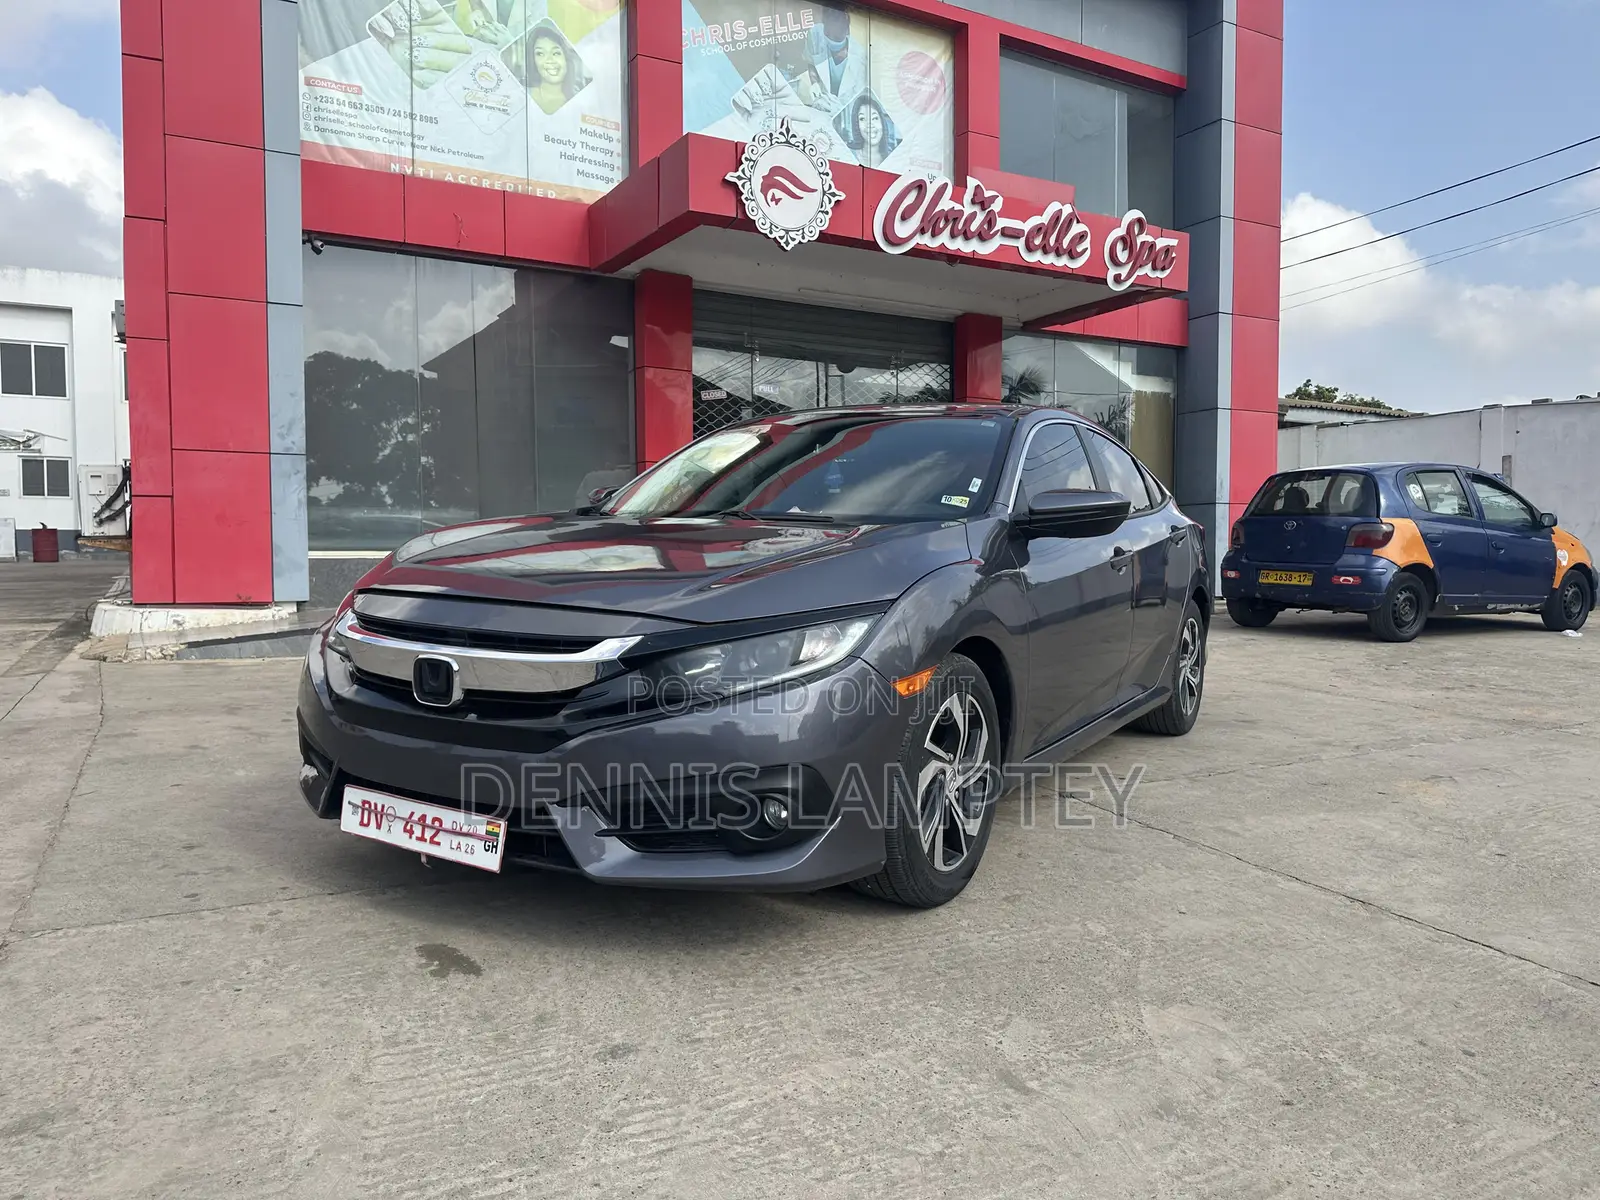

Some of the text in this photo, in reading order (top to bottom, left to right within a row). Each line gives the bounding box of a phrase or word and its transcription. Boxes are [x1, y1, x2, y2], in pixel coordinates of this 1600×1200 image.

[700, 30, 809, 56] SCHOOL OF COSMETOLOGY
[310, 79, 359, 93] CONTACT US
[314, 94, 335, 105] +233
[365, 103, 385, 114] 3505
[313, 125, 356, 138] Dansoman
[358, 132, 380, 143] Sharp
[430, 145, 446, 154] Nick
[447, 149, 484, 160] Petroleum
[580, 127, 614, 143] MakeUp
[544, 134, 614, 157] Beauty Therapy
[560, 152, 615, 171] Hairdressing
[390, 162, 557, 199] NVTI ACCREDITED
[577, 169, 615, 184] Massage
[881, 178, 1177, 284] Chris-elle Spa
[701, 391, 727, 399] CLOSED
[1260, 572, 1270, 581] GR
[359, 799, 444, 847] DV 412
[451, 820, 465, 832] DV
[450, 839, 462, 852] LA
[483, 838, 499, 855] GH
